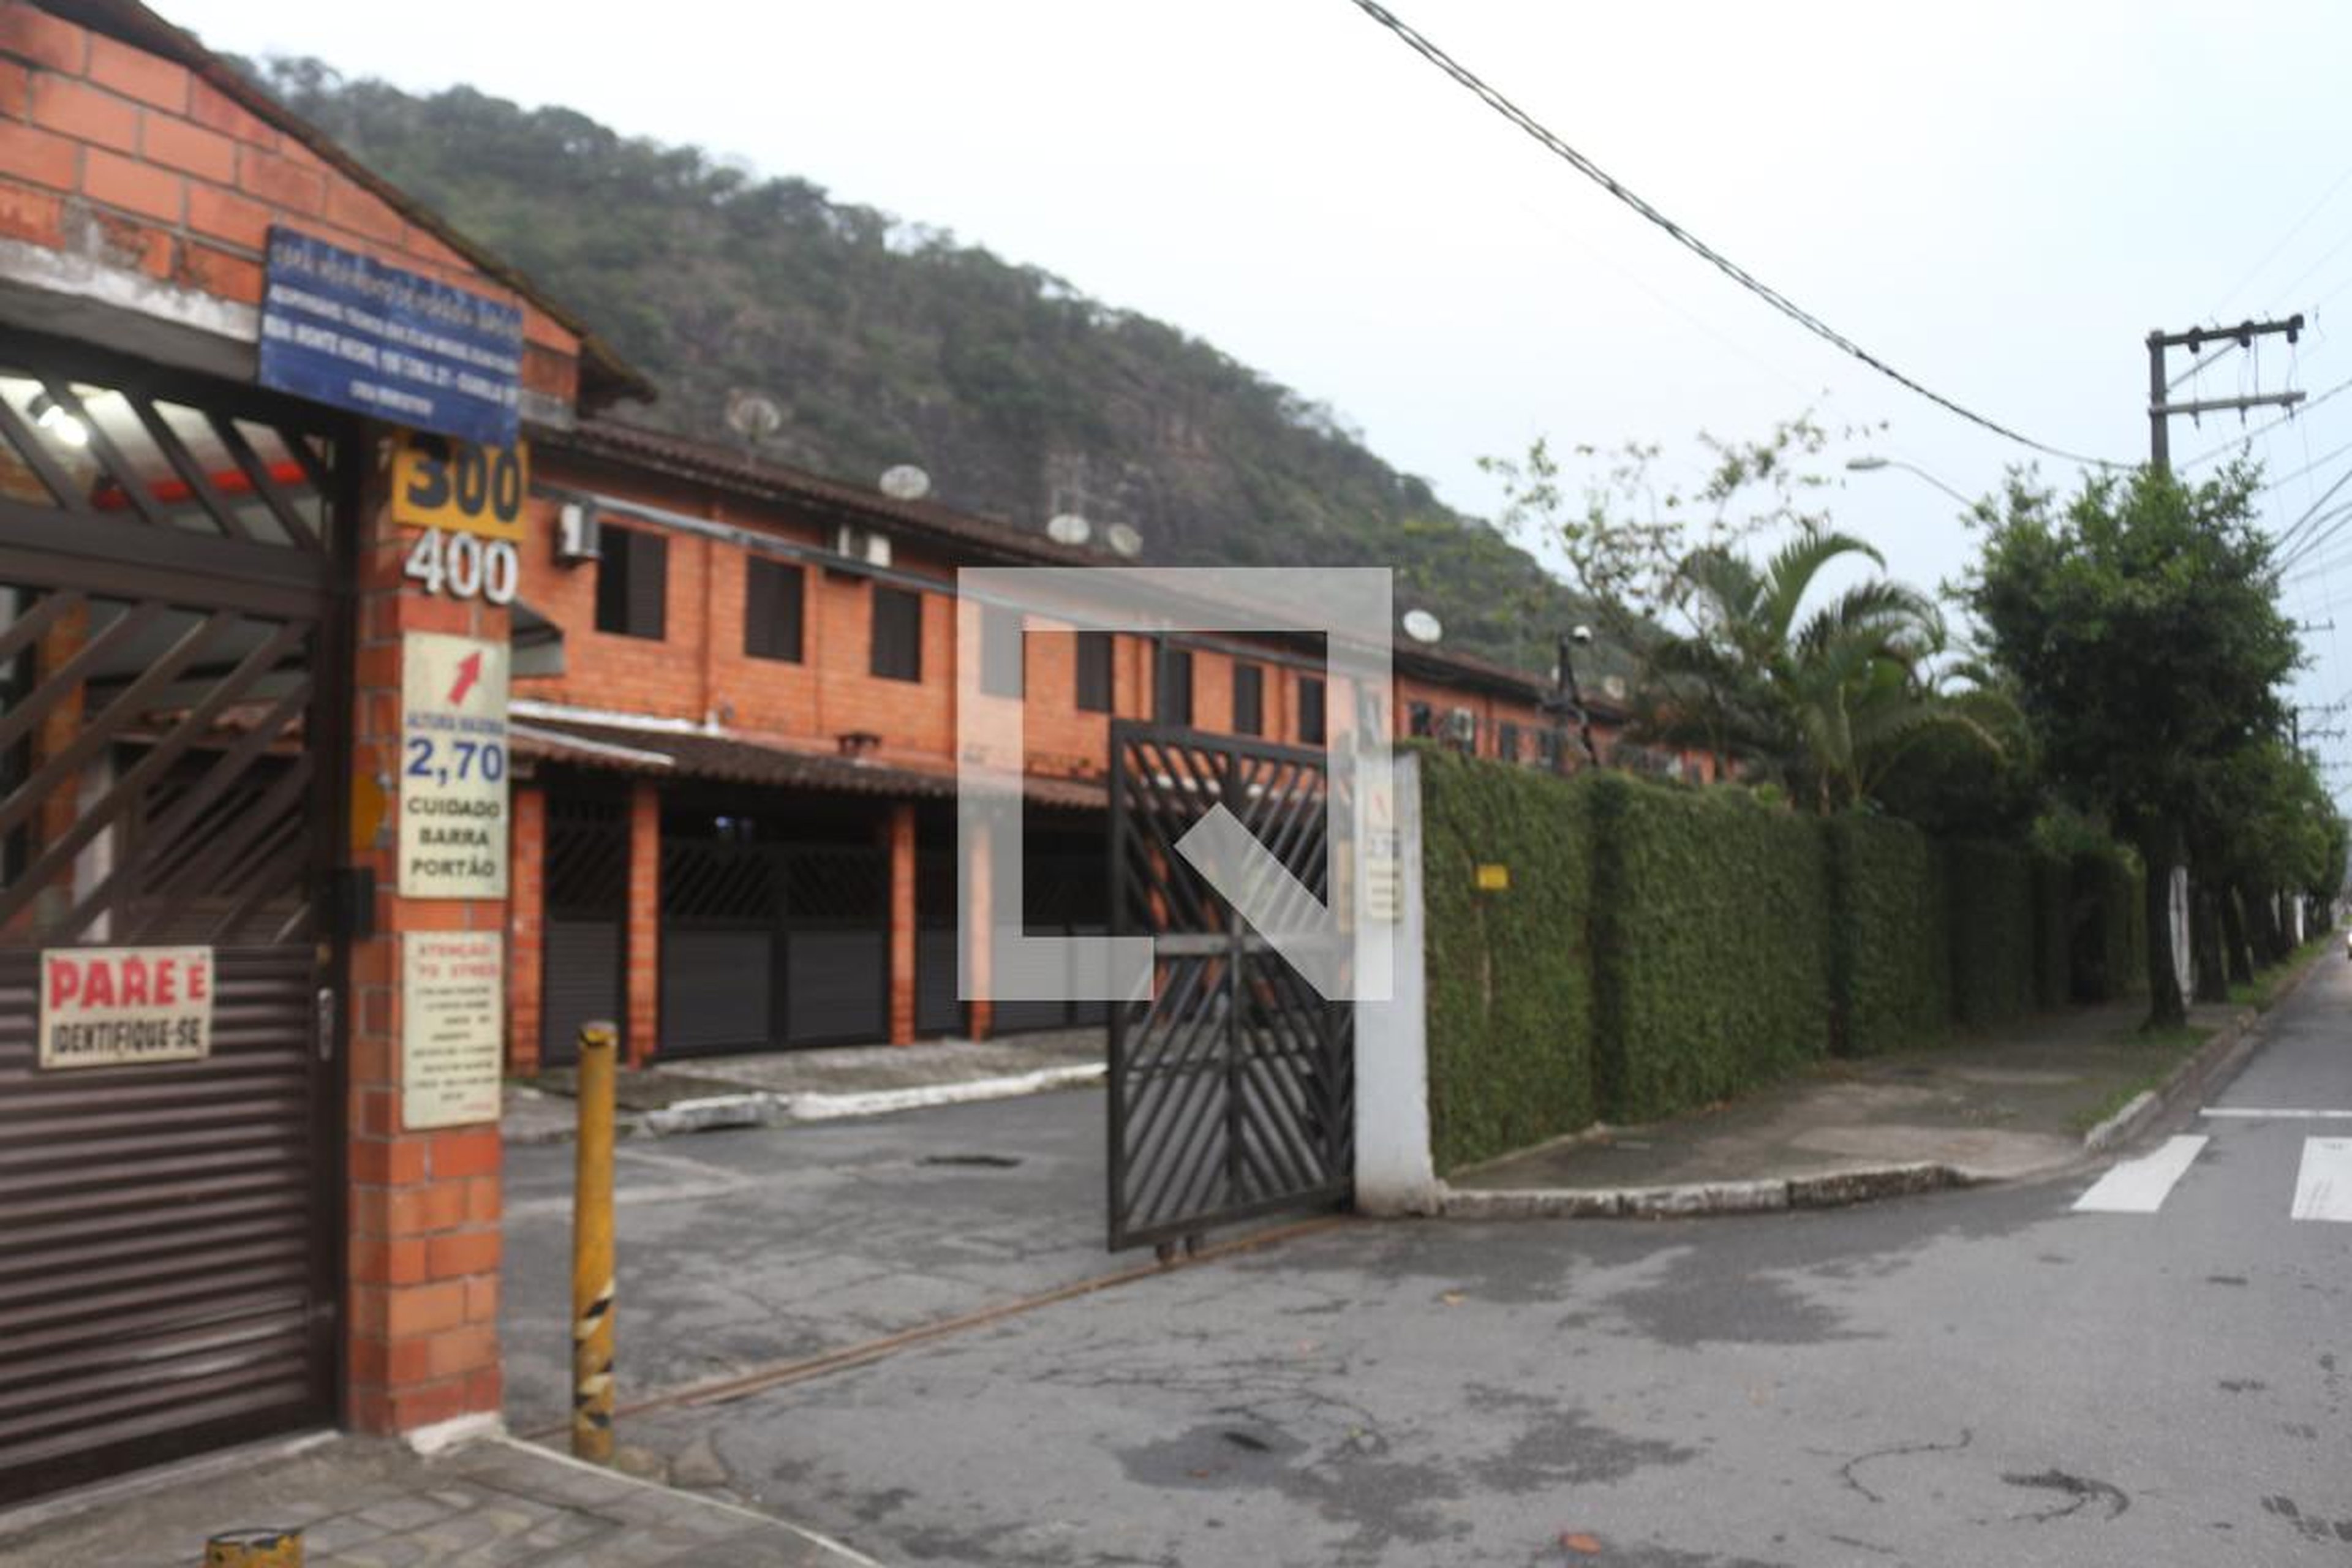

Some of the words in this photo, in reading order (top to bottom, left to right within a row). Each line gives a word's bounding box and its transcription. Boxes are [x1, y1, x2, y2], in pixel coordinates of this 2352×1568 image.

[407, 445, 521, 524] 300
[404, 526, 519, 605] 400
[407, 737, 504, 786] 2,70
[408, 797, 500, 818] CUIDADO
[420, 827, 489, 846] BARRA
[49, 956, 176, 1011] PARE
[187, 962, 206, 1000] E
[51, 1018, 201, 1054] IDENTIFIQUE-SE
